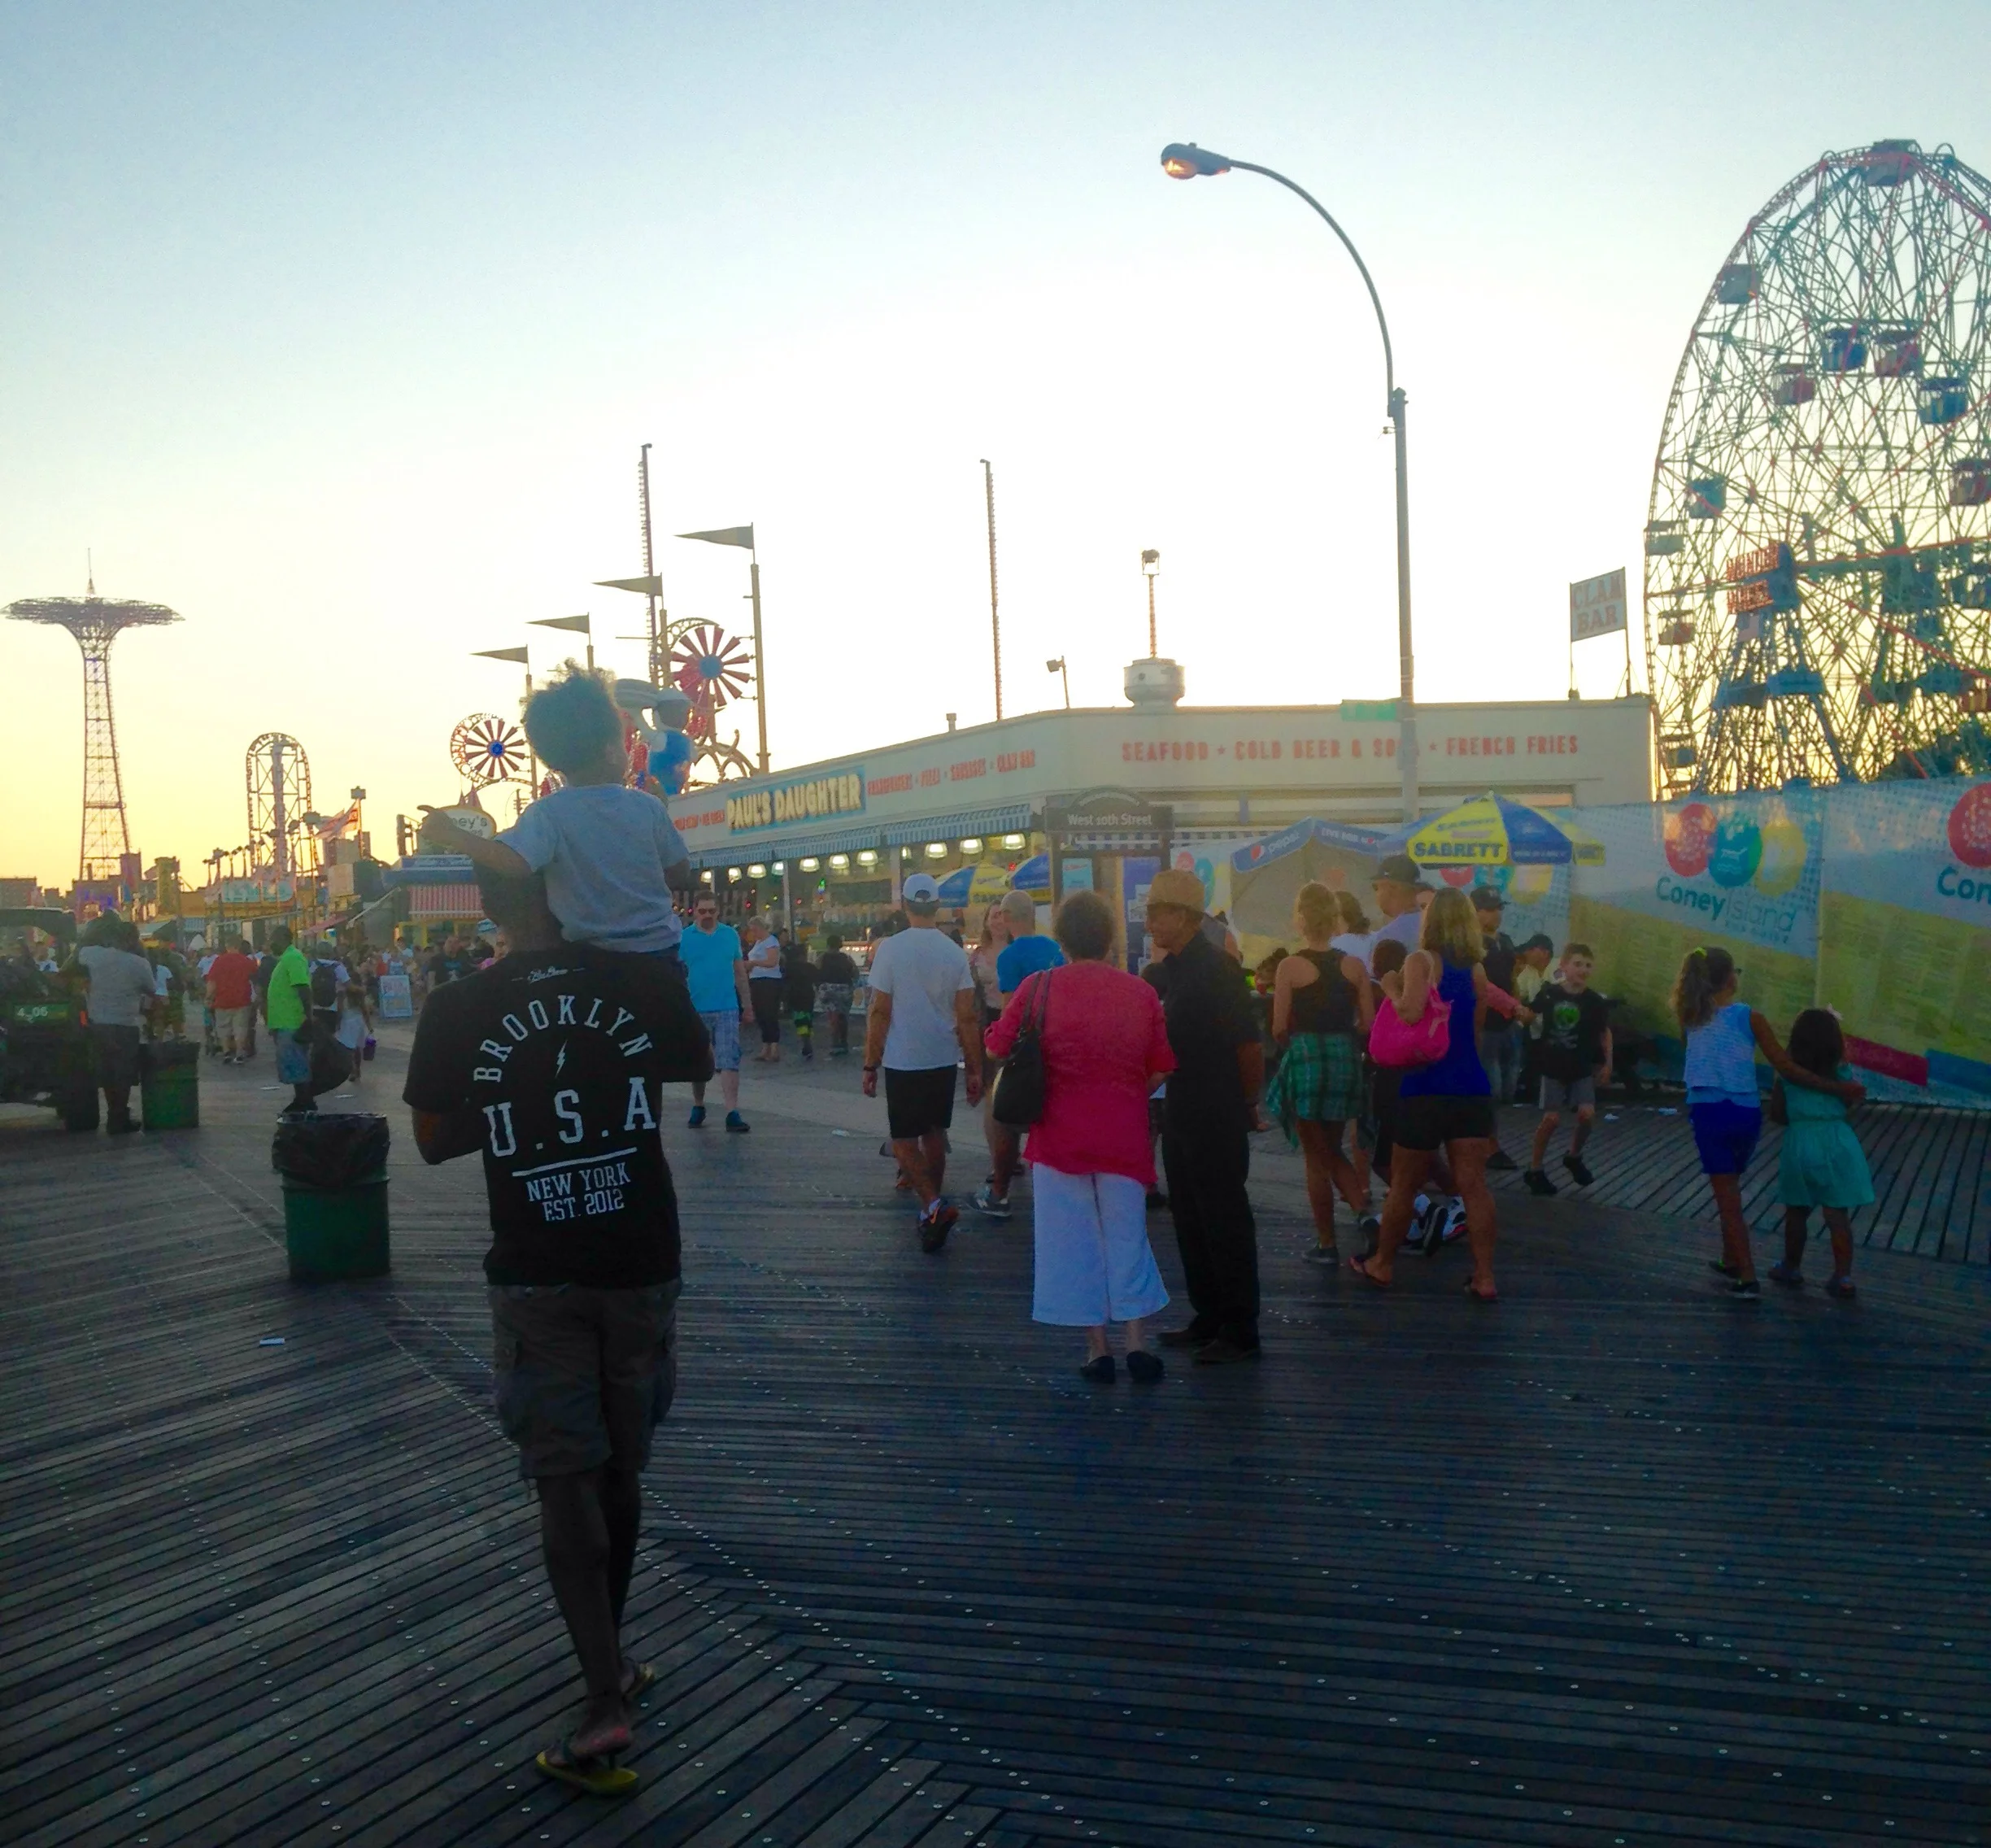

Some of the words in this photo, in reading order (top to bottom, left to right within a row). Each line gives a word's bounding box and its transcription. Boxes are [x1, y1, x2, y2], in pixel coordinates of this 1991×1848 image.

[1574, 573, 1623, 608] CLAM
[1578, 605, 1618, 635] BAR
[1122, 741, 1209, 761] SEAFOOD
[1234, 739, 1282, 760] COLD
[1293, 739, 1340, 759] BEER
[1373, 738, 1420, 757] SO
[1446, 736, 1515, 755] FRENCH
[1527, 735, 1579, 754] FRIES
[727, 791, 772, 830] PAUL'S
[775, 774, 861, 822] DAUGHTER
[1068, 814, 1094, 826] West
[1096, 813, 1118, 826] 10th
[1121, 813, 1152, 826] Street
[1414, 841, 1503, 857] SABRETT
[1656, 876, 1726, 921] Coney
[473, 994, 653, 1083] BROOKLYN
[525, 1172, 572, 1202] NEW
[578, 1162, 631, 1191] YORK
[542, 1196, 582, 1221] EST.
[584, 1188, 625, 1214] 2012
